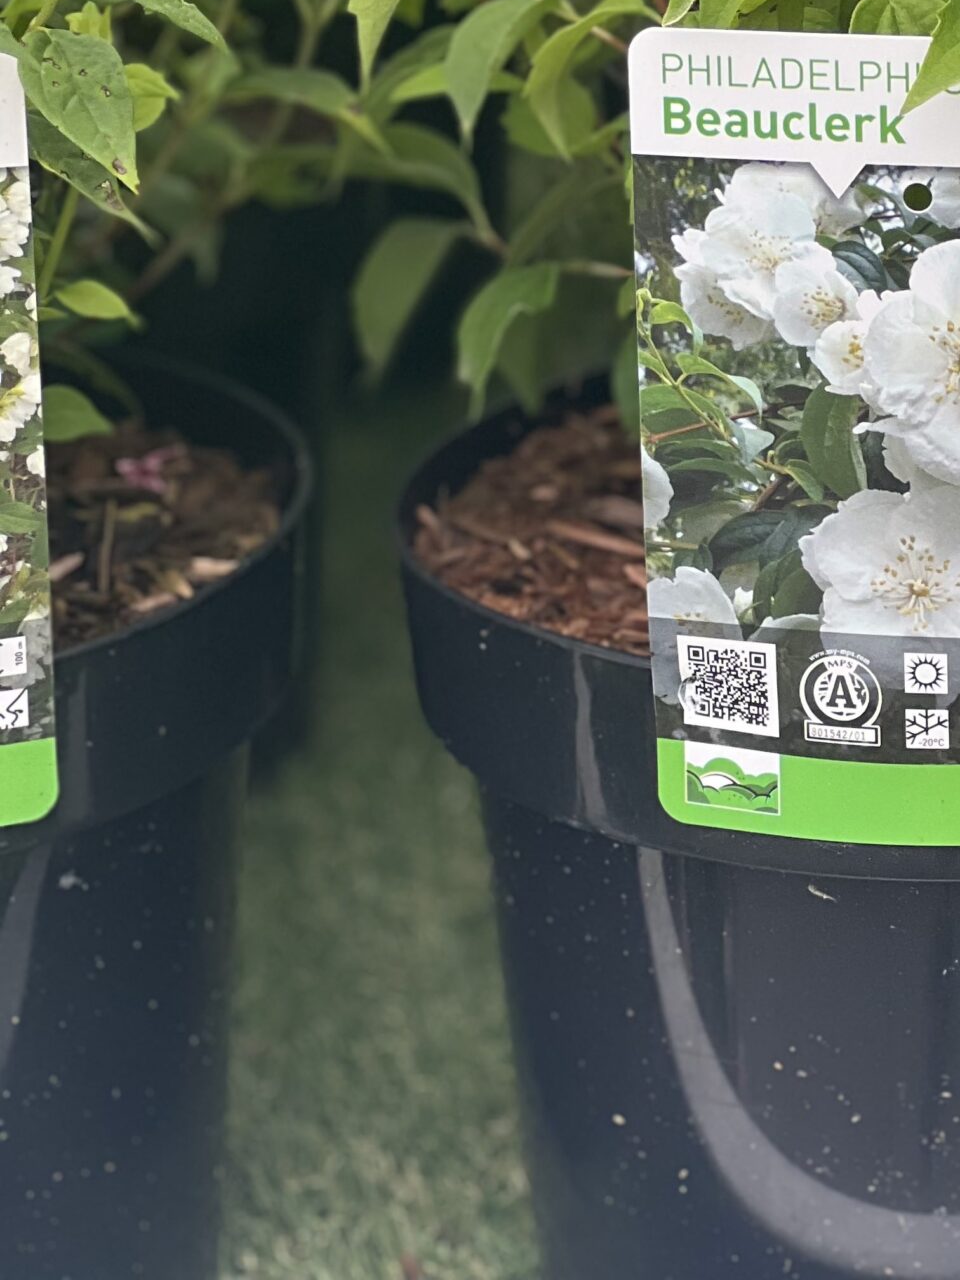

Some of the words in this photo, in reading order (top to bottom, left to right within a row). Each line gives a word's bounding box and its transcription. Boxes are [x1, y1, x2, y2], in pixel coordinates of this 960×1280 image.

[662, 96, 906, 144] Beauclerk
[14, 651, 24, 666] 100
[828, 659, 853, 669] MPS
[826, 674, 857, 709] A
